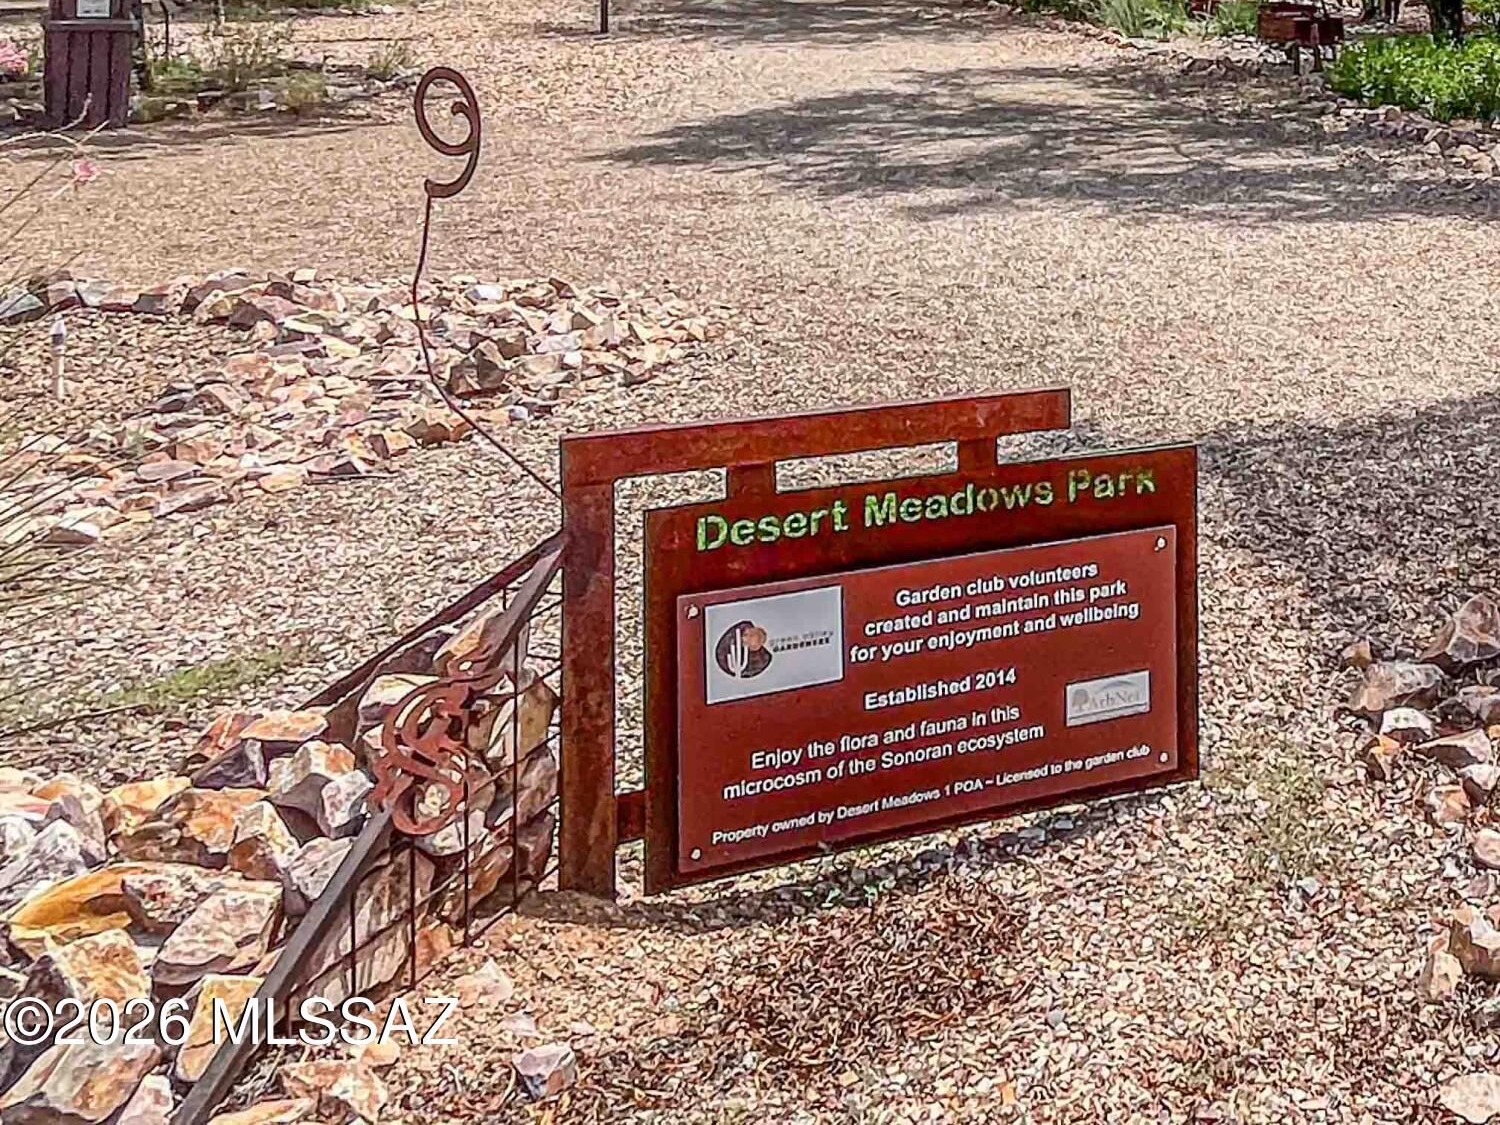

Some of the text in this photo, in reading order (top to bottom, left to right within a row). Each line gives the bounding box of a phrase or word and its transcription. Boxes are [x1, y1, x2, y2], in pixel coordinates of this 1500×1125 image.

[696, 467, 1156, 552] Desert Meadows Park
[864, 580, 1127, 636] created and maintain this park
[896, 563, 1098, 606] Garden club volunteers
[850, 602, 1140, 662] for your enjoyment and wellbeing
[865, 668, 1017, 710] Established 2014
[723, 725, 1044, 800] microcosm of the Sonoran ecosystem
[752, 706, 1020, 769] Enjoy the flora and fauna in this
[712, 823, 769, 845] Property
[772, 813, 816, 833] owned
[818, 810, 835, 825] by
[837, 801, 879, 819] Desert
[882, 788, 941, 810] Meadows
[944, 784, 951, 796] 1
[954, 778, 983, 795] POA
[996, 764, 1048, 786] Licensed
[1050, 763, 1062, 775] to
[1065, 760, 1083, 772] the
[1085, 750, 1124, 771] garden
[1126, 745, 1150, 759] club
